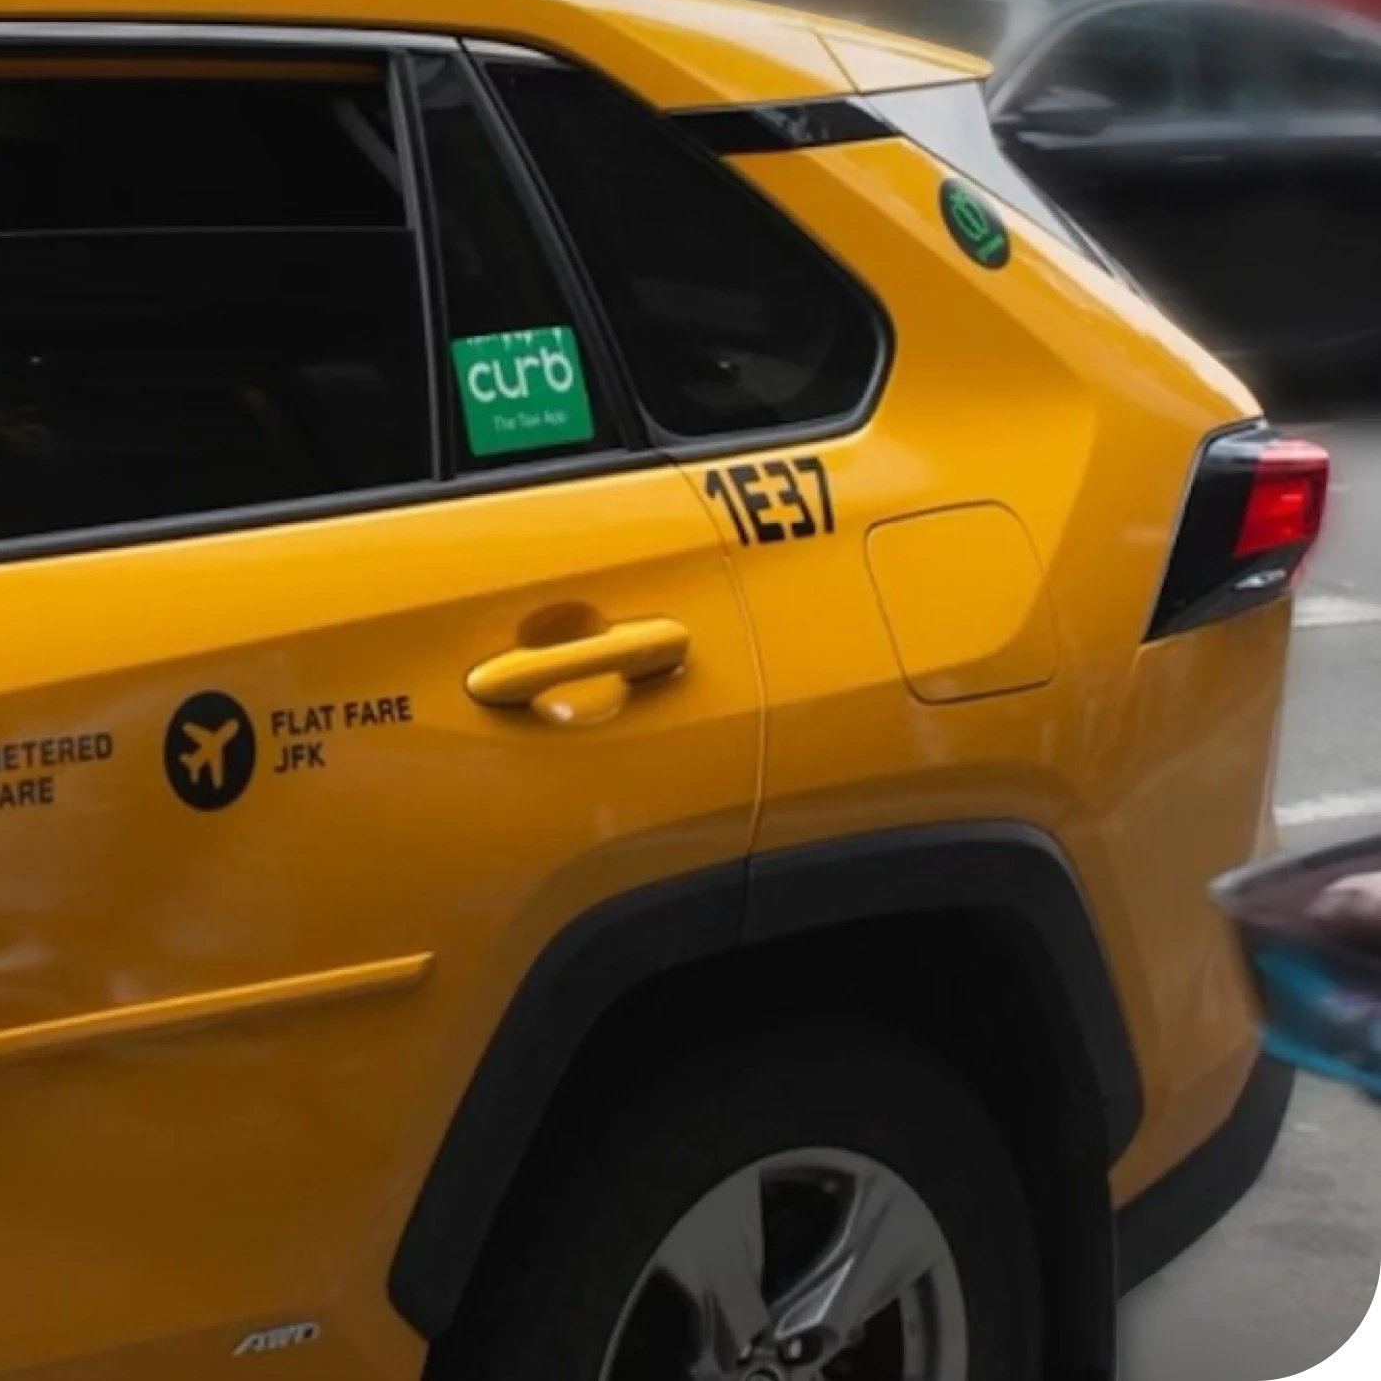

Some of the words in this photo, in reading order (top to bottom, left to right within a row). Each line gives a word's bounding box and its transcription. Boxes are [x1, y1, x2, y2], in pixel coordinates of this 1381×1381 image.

[468, 346, 575, 404] curb
[704, 456, 835, 547] 1E37
[270, 704, 335, 738] FLAT
[345, 695, 413, 729] FARE
[273, 742, 326, 774] JFK
